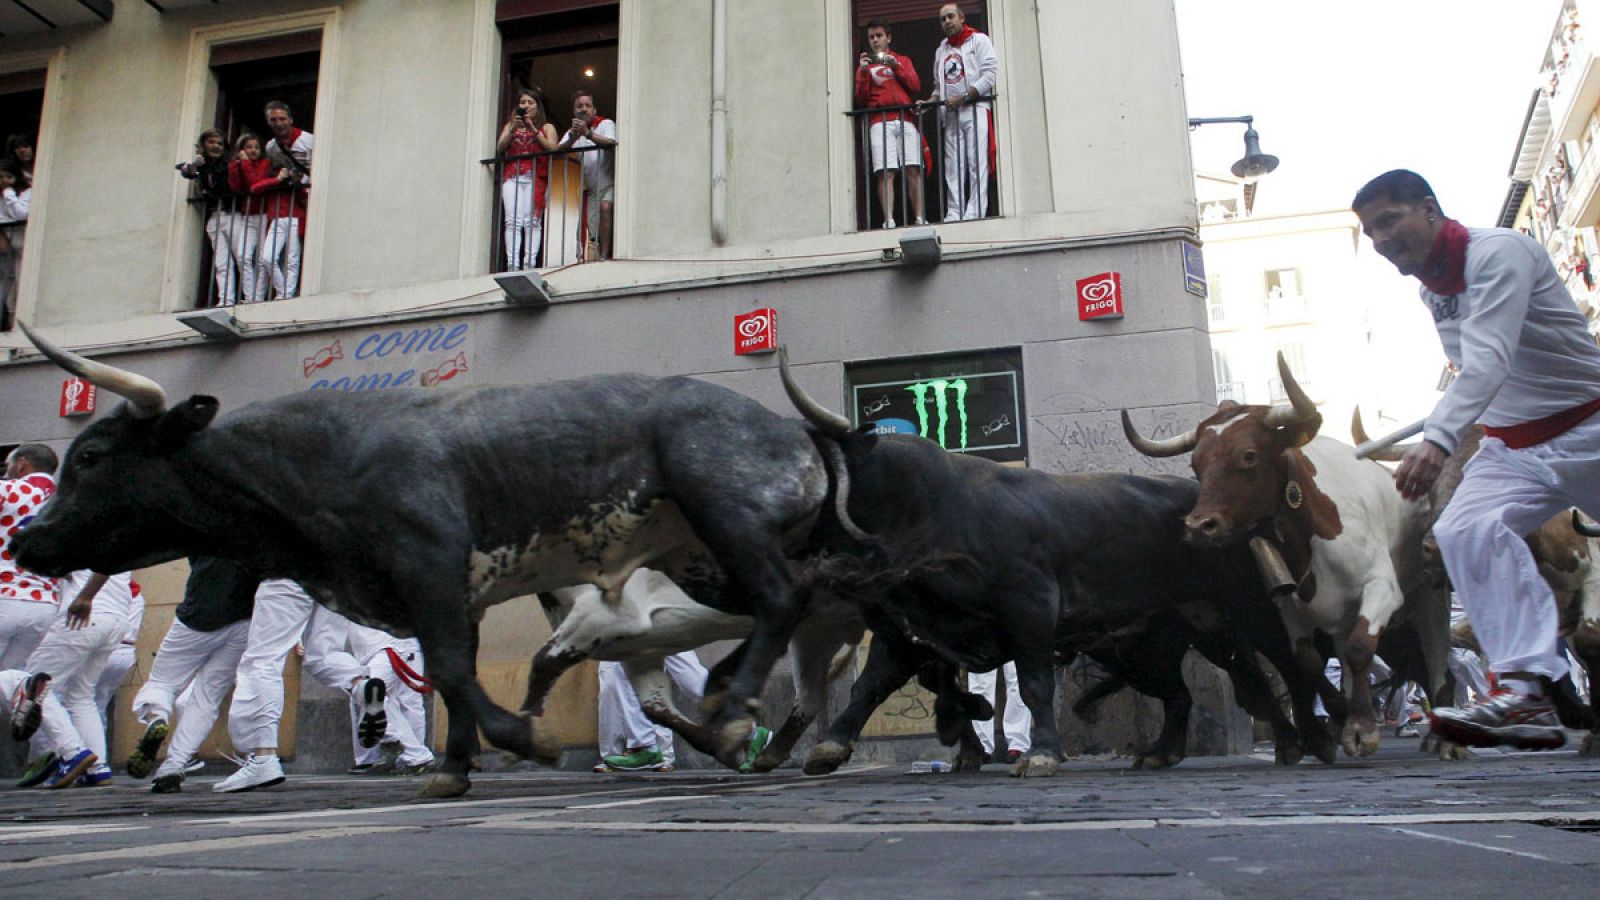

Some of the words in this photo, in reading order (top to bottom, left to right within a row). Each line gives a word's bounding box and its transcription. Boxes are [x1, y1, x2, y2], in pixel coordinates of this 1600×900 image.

[1085, 299, 1113, 312] FRIGO
[355, 323, 469, 361] come
[740, 335, 765, 348] FRIGO
